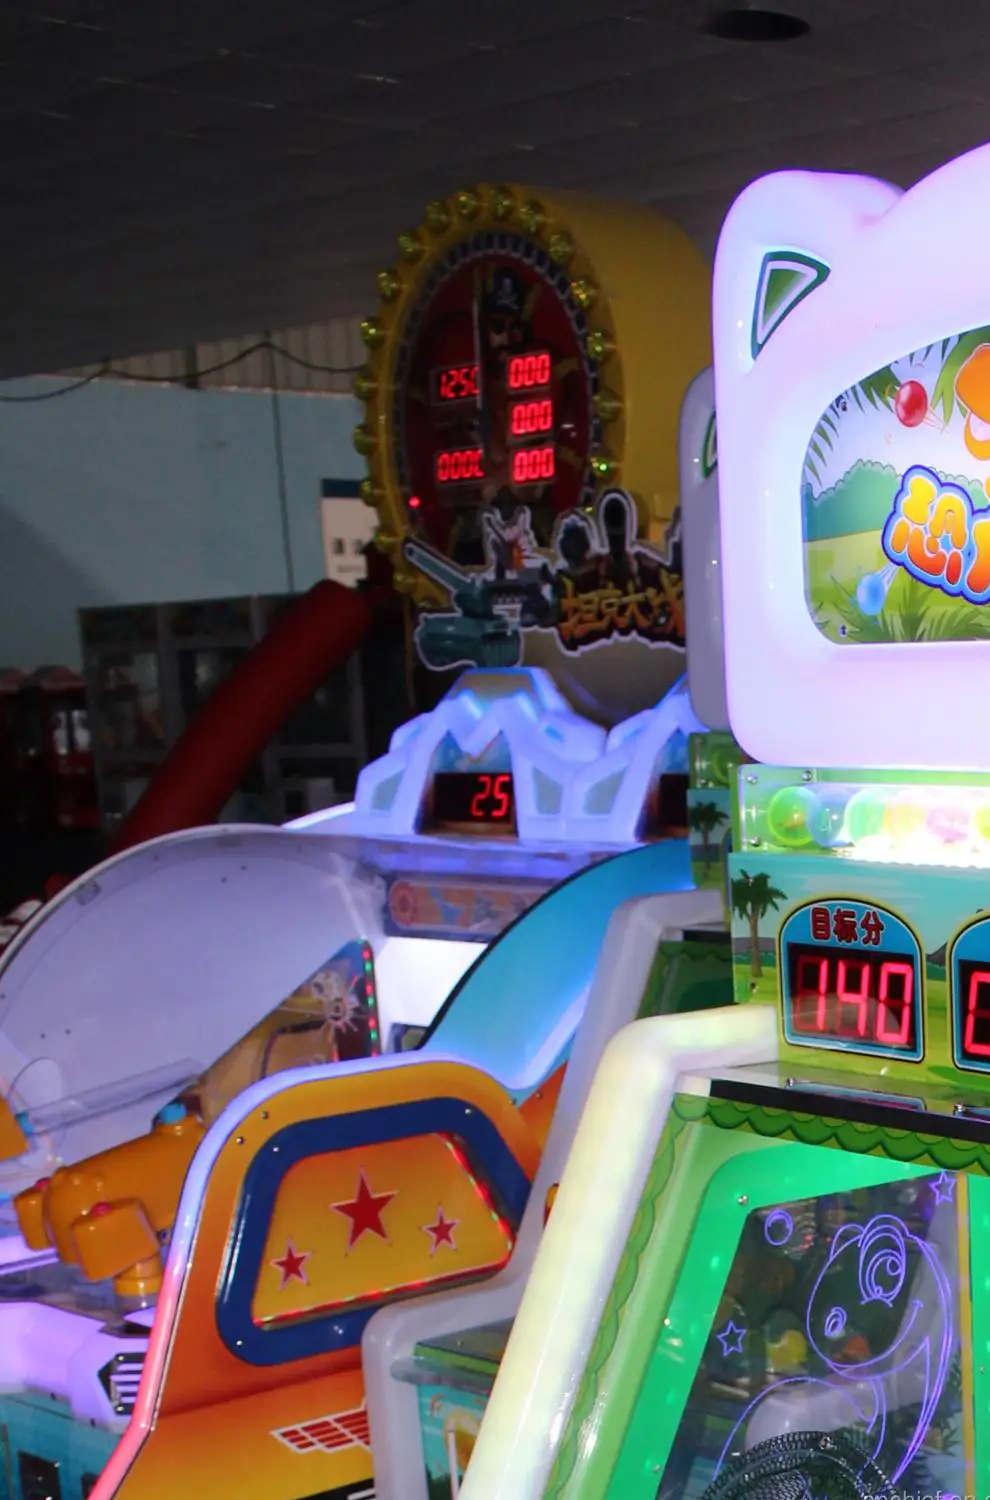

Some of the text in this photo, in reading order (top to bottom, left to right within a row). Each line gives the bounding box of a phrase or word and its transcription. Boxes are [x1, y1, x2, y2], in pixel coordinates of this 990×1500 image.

[508, 353, 551, 388] 000
[511, 400, 553, 435] 000
[513, 447, 555, 483] 000
[470, 775, 511, 818] 25
[809, 907, 885, 949] 目标分
[815, 959, 914, 1046] 140
